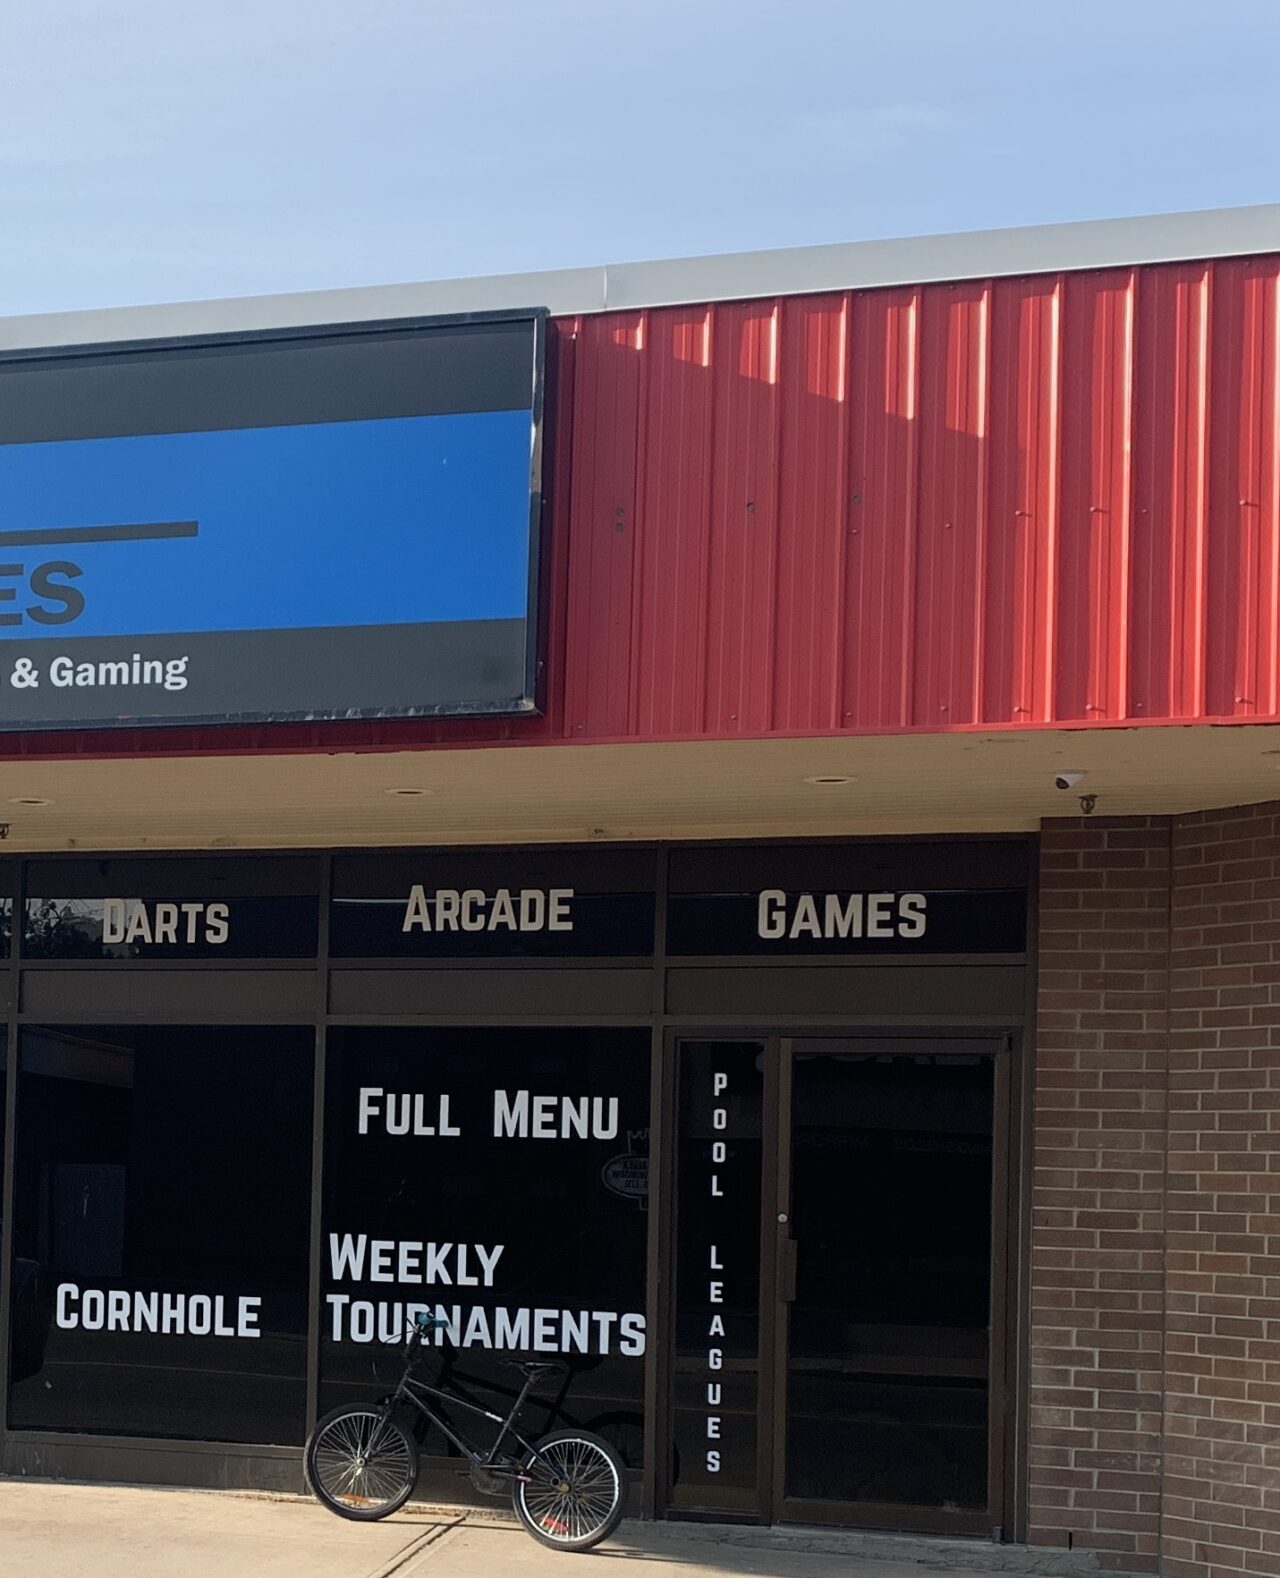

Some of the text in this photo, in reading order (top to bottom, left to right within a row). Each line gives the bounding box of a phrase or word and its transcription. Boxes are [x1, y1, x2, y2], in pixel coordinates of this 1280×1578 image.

[10, 657, 39, 688] &
[49, 653, 189, 691] Gaming
[102, 897, 230, 944] DARTS
[402, 884, 575, 932] ARCADE
[758, 889, 927, 939] GAMES
[358, 1087, 619, 1140] FULL MENU
[329, 1232, 505, 1287] WEEKLY
[706, 1072, 728, 1472] POOL LEAGUES
[56, 1283, 262, 1338] CORNHOLE
